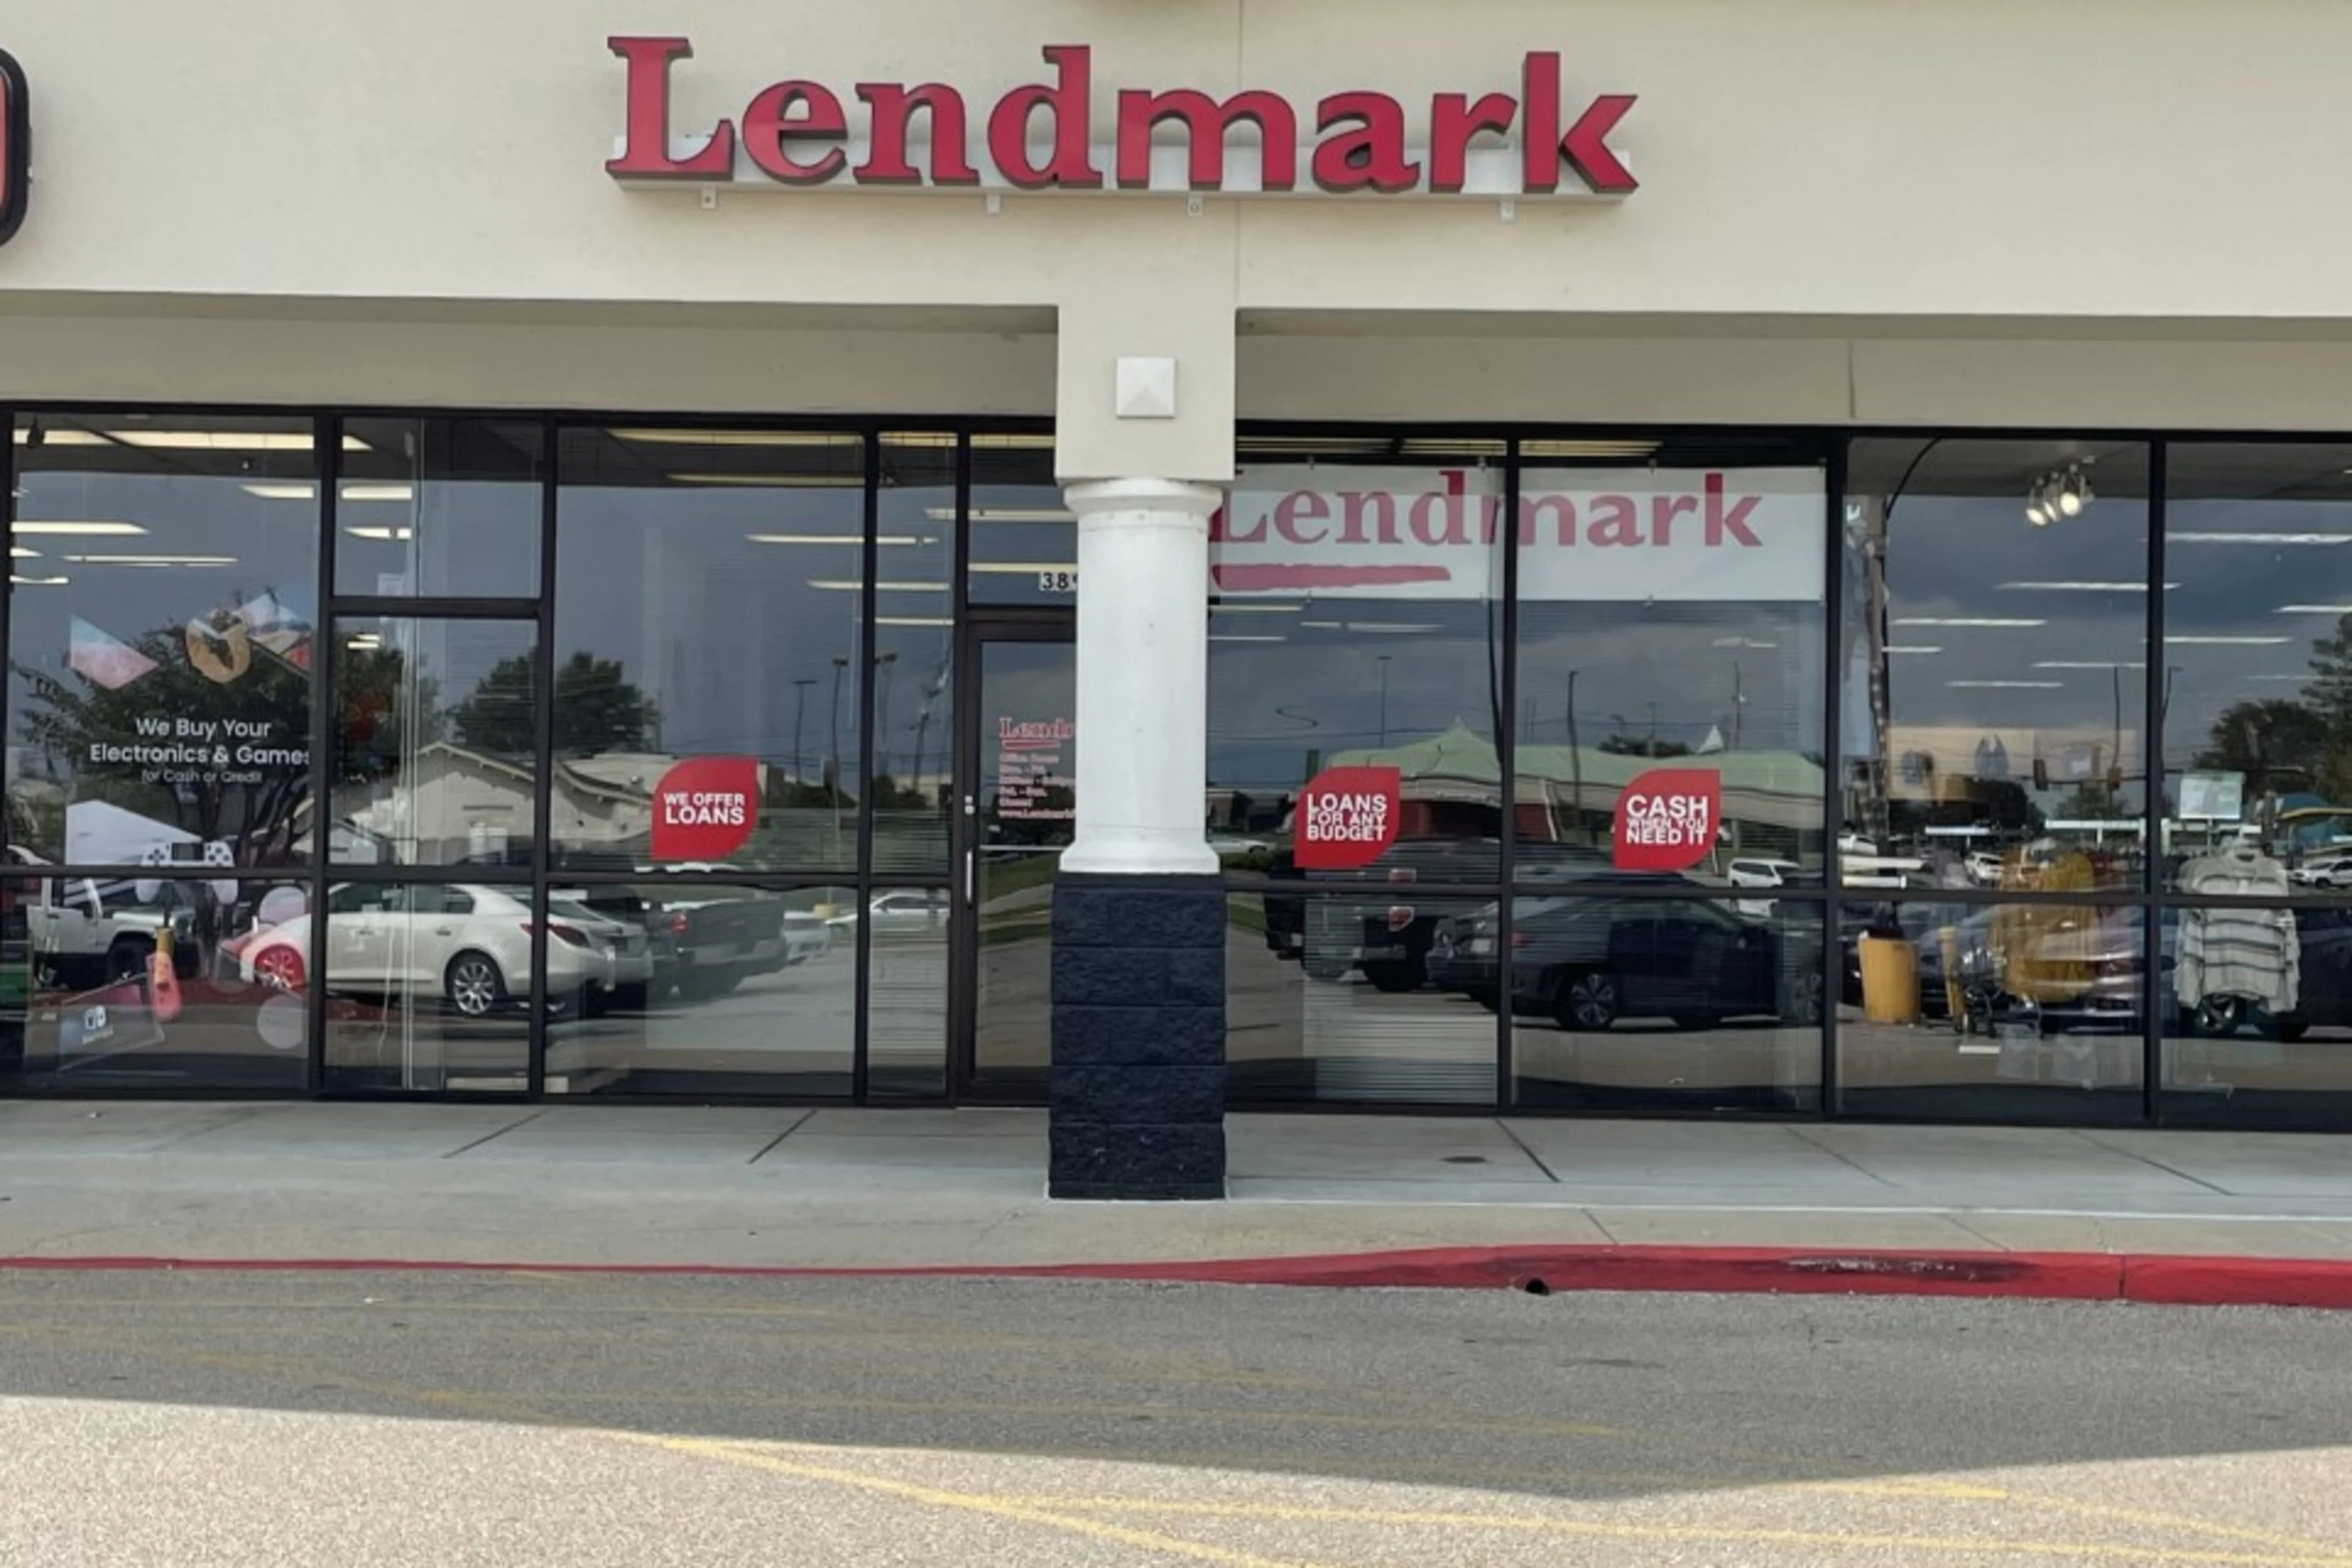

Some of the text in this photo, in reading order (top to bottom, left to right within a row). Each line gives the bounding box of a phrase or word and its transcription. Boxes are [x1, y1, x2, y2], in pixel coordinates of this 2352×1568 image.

[605, 37, 1640, 194] Lendmark
[1208, 470, 1763, 546] Lendmark
[136, 718, 271, 742] We Buy Your
[999, 717, 1076, 738] Lend
[91, 743, 309, 765] Electronics & Games
[141, 768, 262, 784] for Cash or Credit
[663, 792, 745, 807] WE OFFER
[1307, 793, 1387, 812] LOANS
[1626, 794, 1709, 818] CASH
[666, 806, 745, 826] LOANS
[1307, 811, 1387, 826] FOR ANY
[1676, 817, 1708, 830] YOU
[1306, 825, 1387, 842] BUDGET
[1626, 828, 1708, 846] NEED IT
